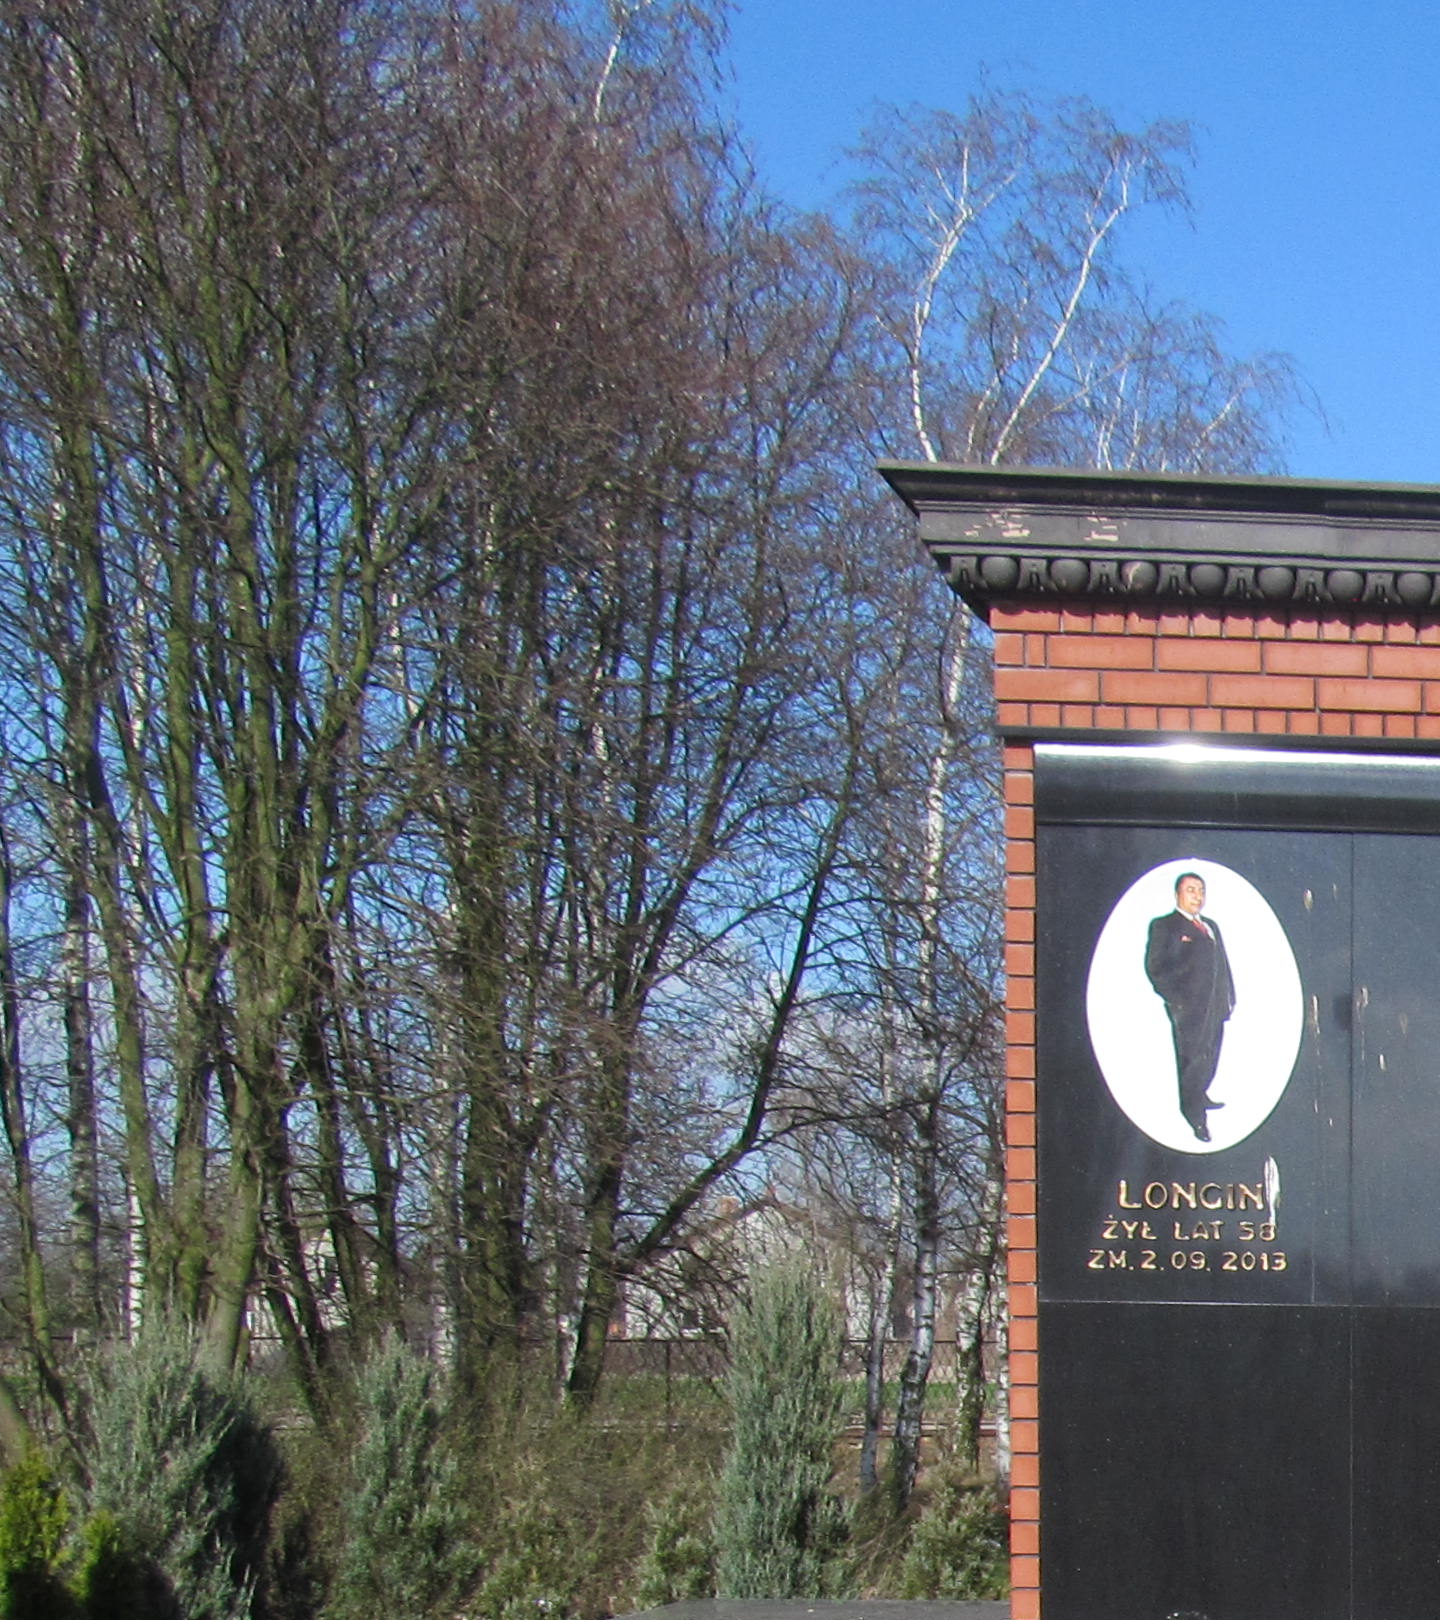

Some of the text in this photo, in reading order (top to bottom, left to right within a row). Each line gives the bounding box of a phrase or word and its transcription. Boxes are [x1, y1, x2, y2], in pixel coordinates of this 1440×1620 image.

[1117, 1179, 1265, 1209] LONGIN
[1101, 1214, 1276, 1241] ŻYŁ LAT 58
[1222, 1252, 1288, 1271] 2013
